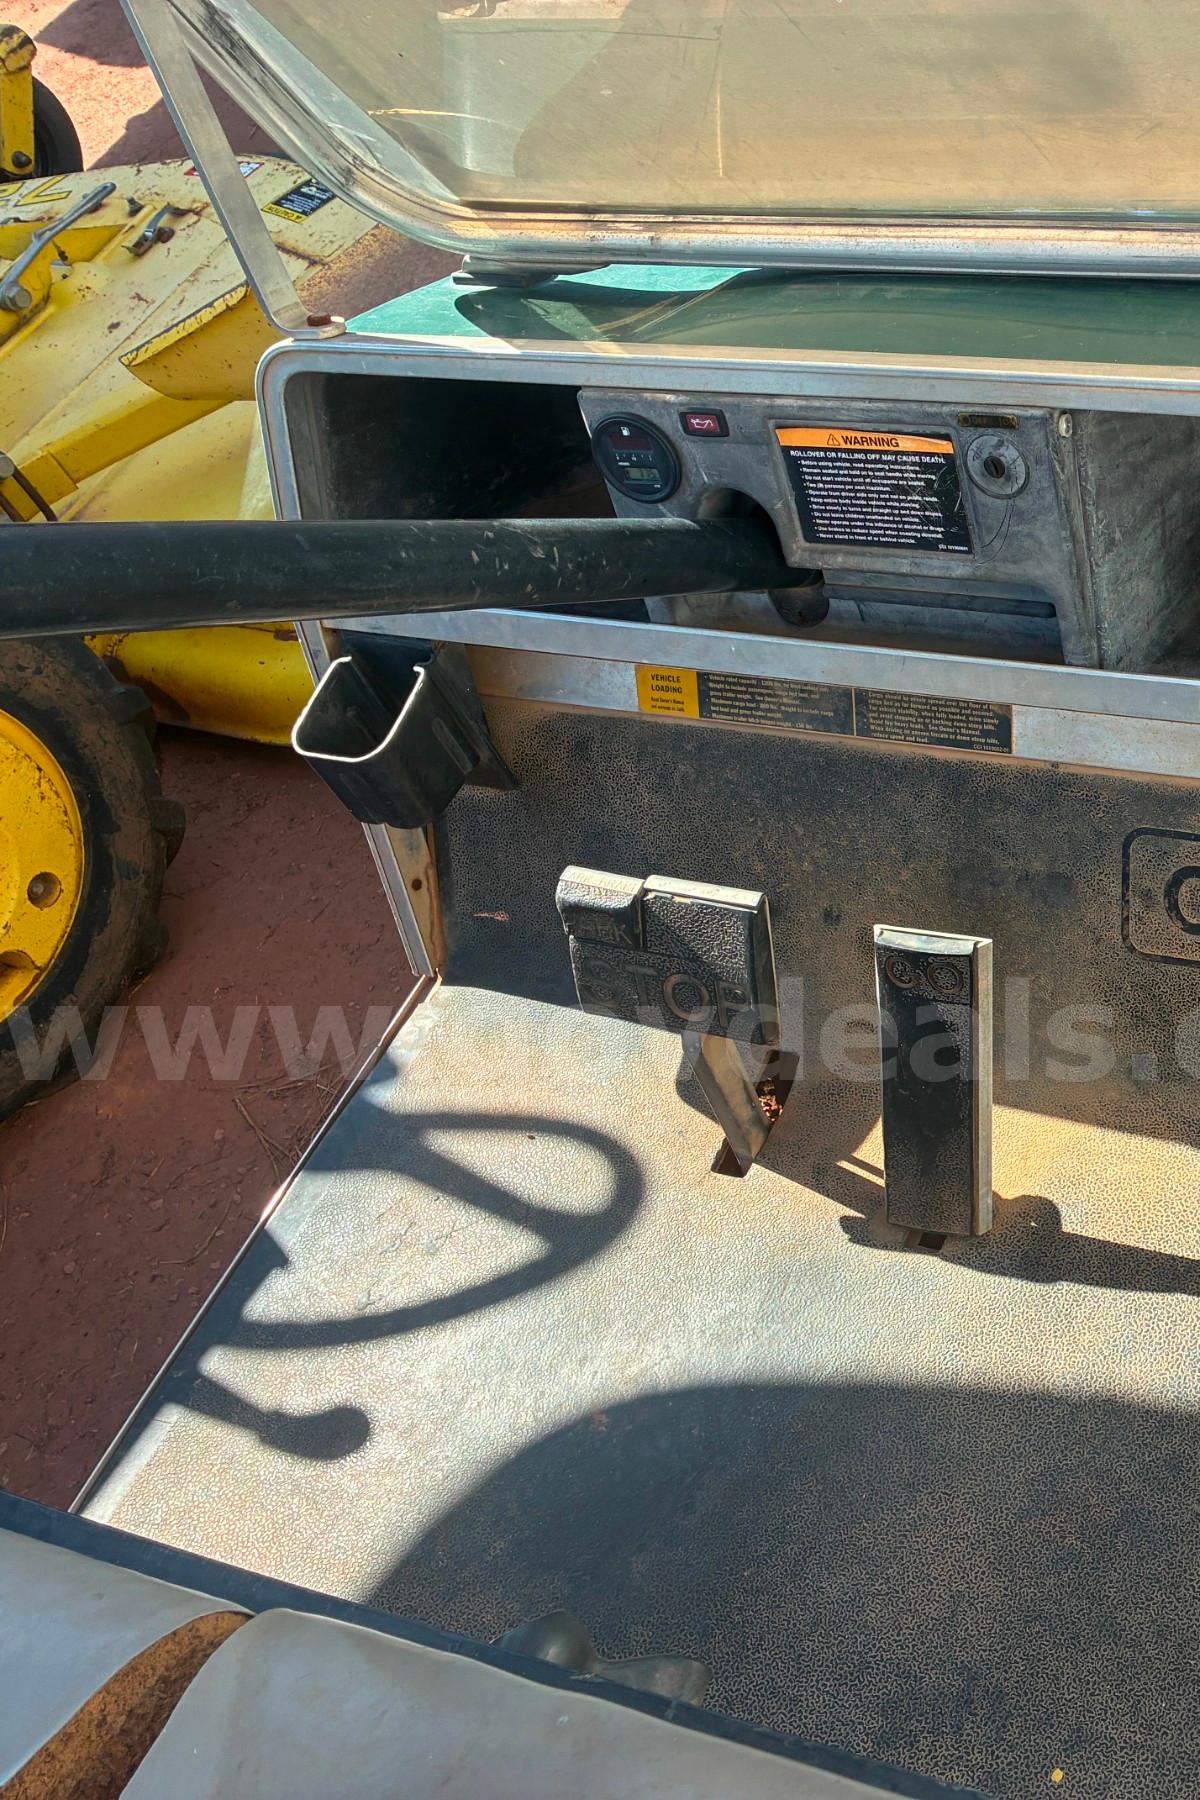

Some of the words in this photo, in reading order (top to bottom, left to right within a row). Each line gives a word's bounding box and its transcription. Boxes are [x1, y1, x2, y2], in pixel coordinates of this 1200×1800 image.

[841, 435, 900, 448] WARNING
[790, 450, 826, 458] ROLLOVER
[837, 452, 866, 460] FALLING
[897, 454, 920, 462] CAUSE
[921, 455, 946, 464] DEATH.
[650, 673, 681, 684] VEHICLE
[651, 684, 683, 694] LOADING
[581, 958, 751, 1028] STOP
